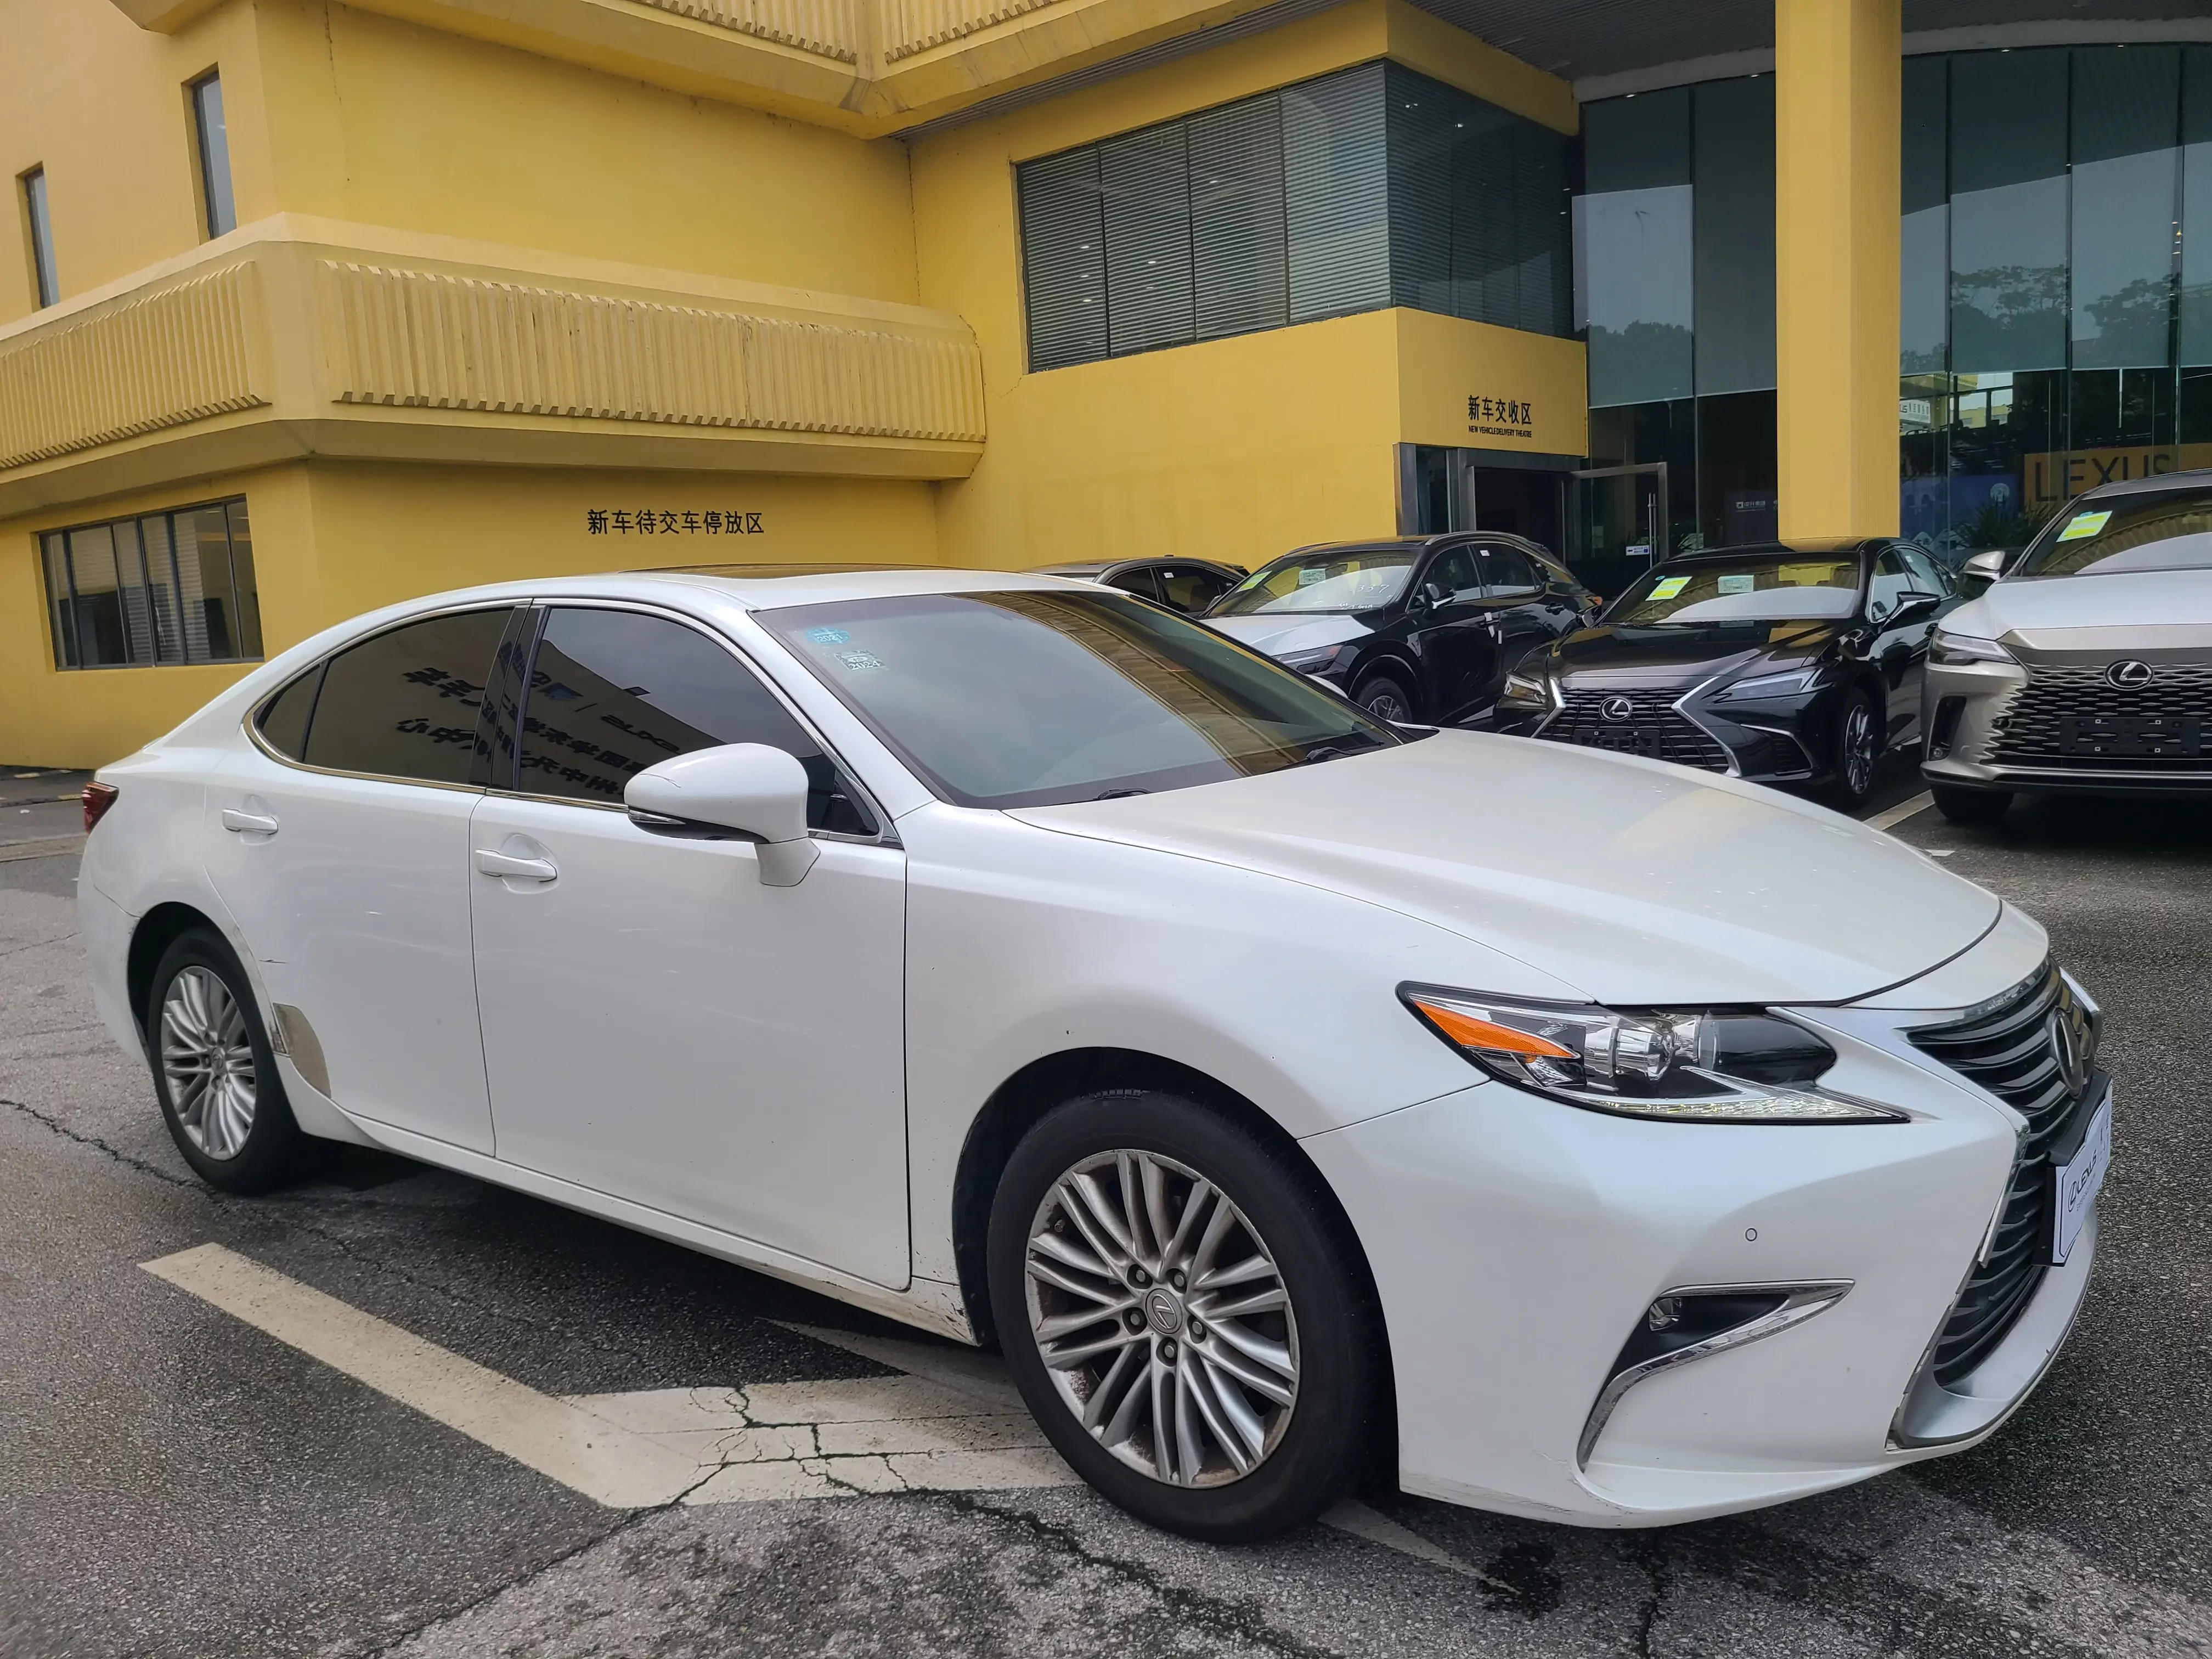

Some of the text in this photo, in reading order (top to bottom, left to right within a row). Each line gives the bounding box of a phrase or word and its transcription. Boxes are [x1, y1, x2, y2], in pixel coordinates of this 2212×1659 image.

[1468, 394, 1532, 425] 新车交收区
[1479, 426, 1497, 435] VEHICLE
[1497, 427, 1515, 437] DELIVERY
[1515, 429, 1532, 438] THEATRE
[587, 509, 765, 535] 新车待交车停放区
[816, 633, 843, 642] 2021
[848, 659, 881, 671] 2024
